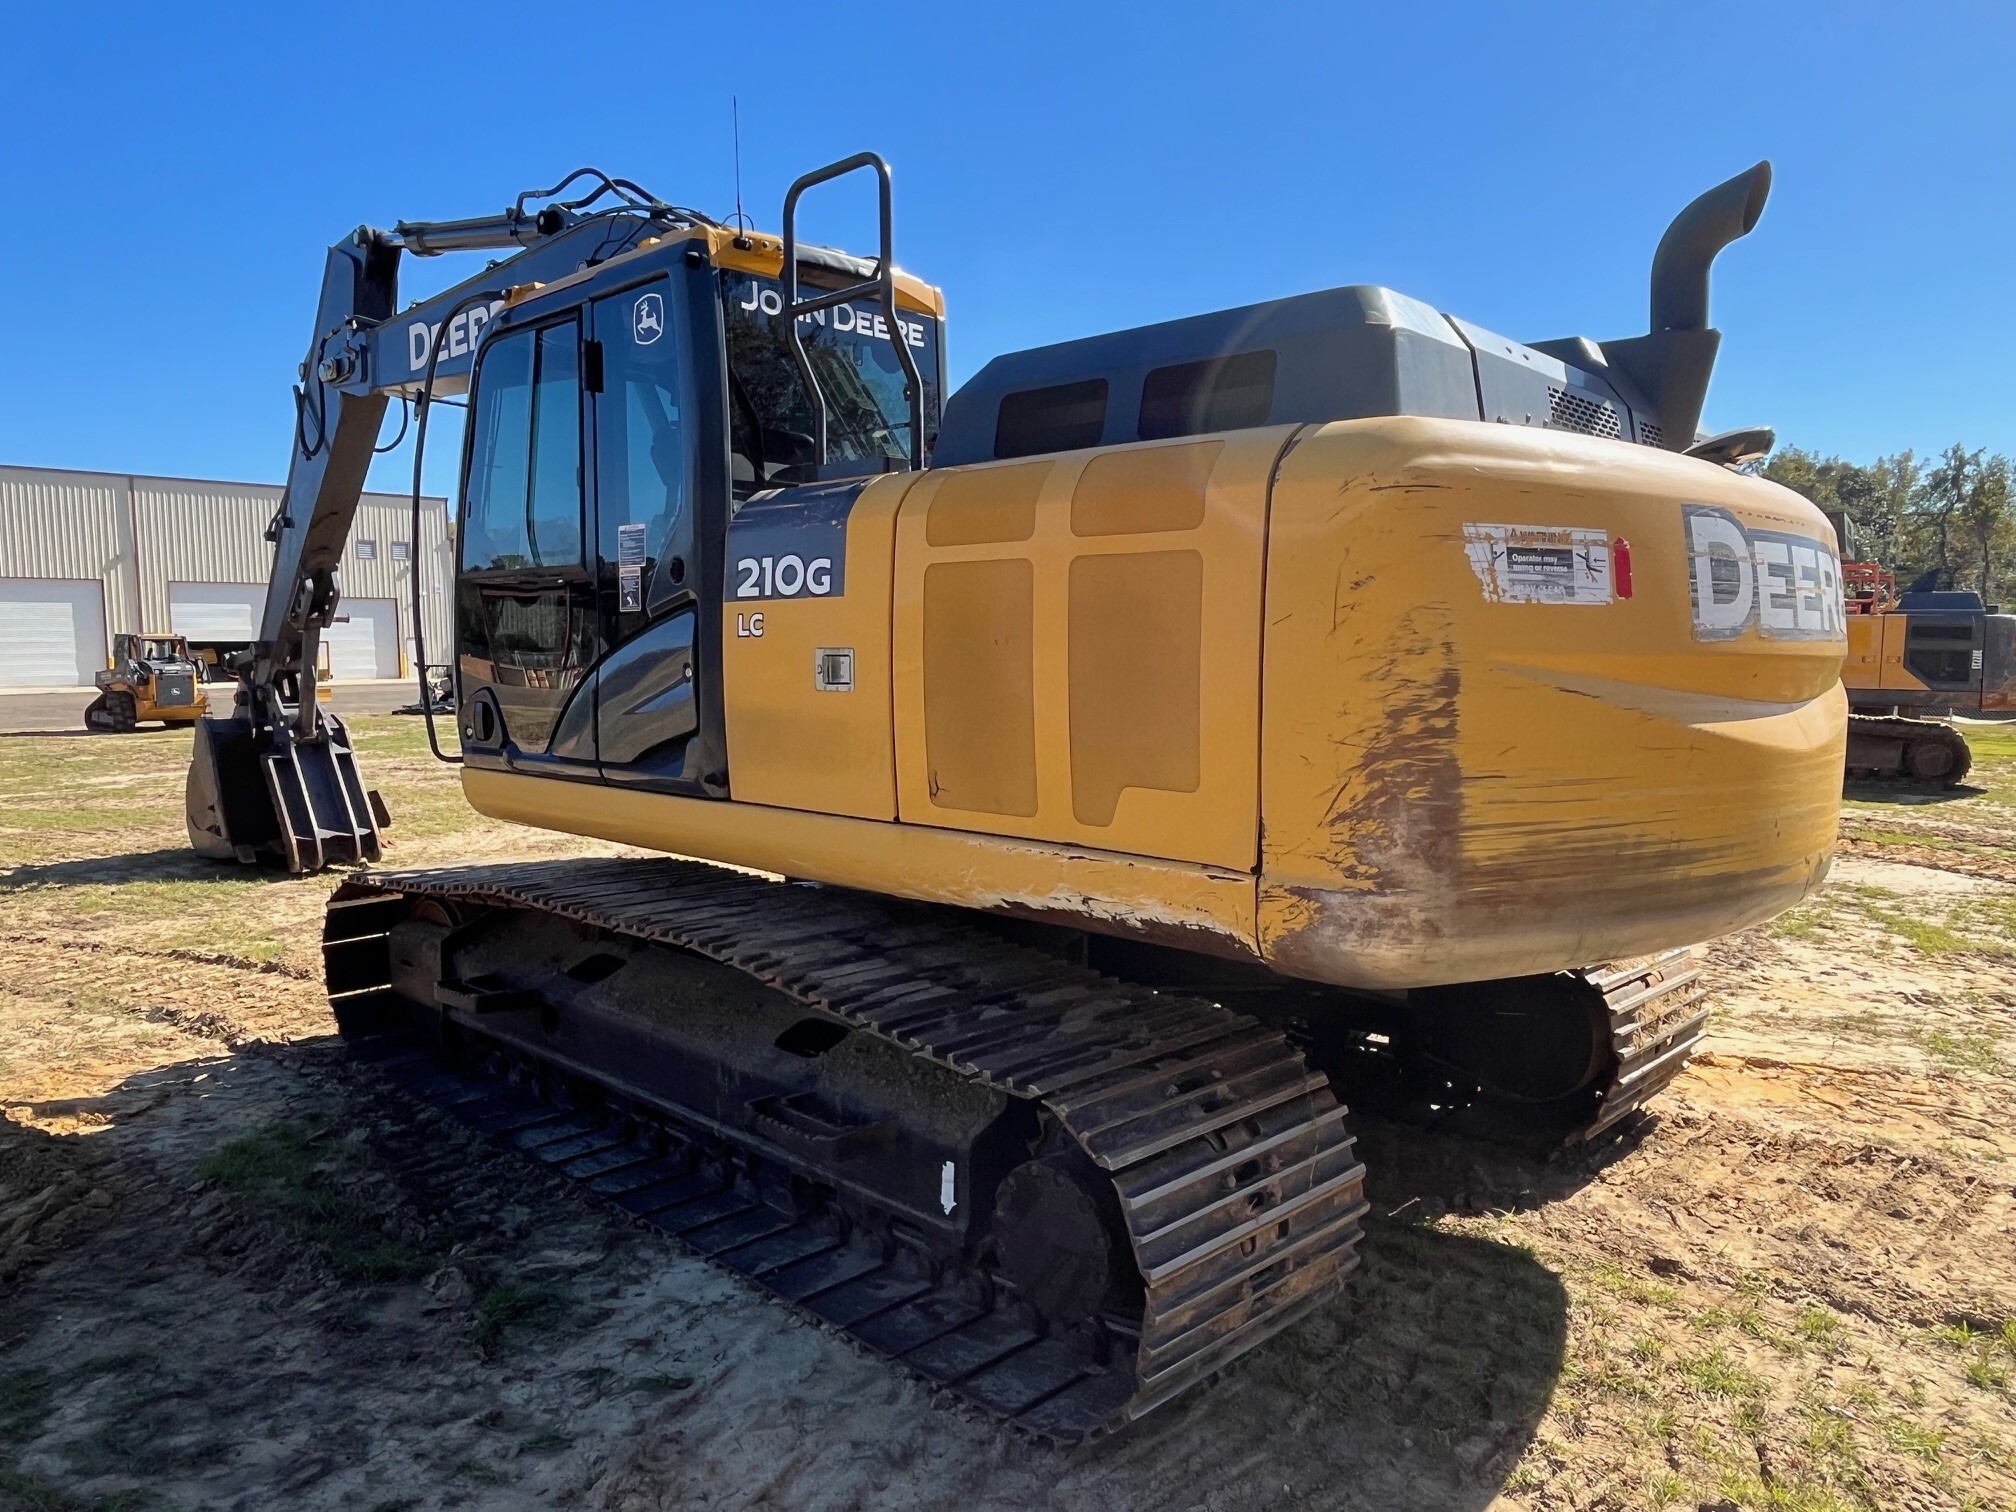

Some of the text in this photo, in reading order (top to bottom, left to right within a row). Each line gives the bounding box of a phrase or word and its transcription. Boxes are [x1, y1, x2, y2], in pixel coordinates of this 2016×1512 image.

[408, 300, 505, 371] DEER
[737, 554, 831, 597] 210G
[738, 613, 764, 637] LC
